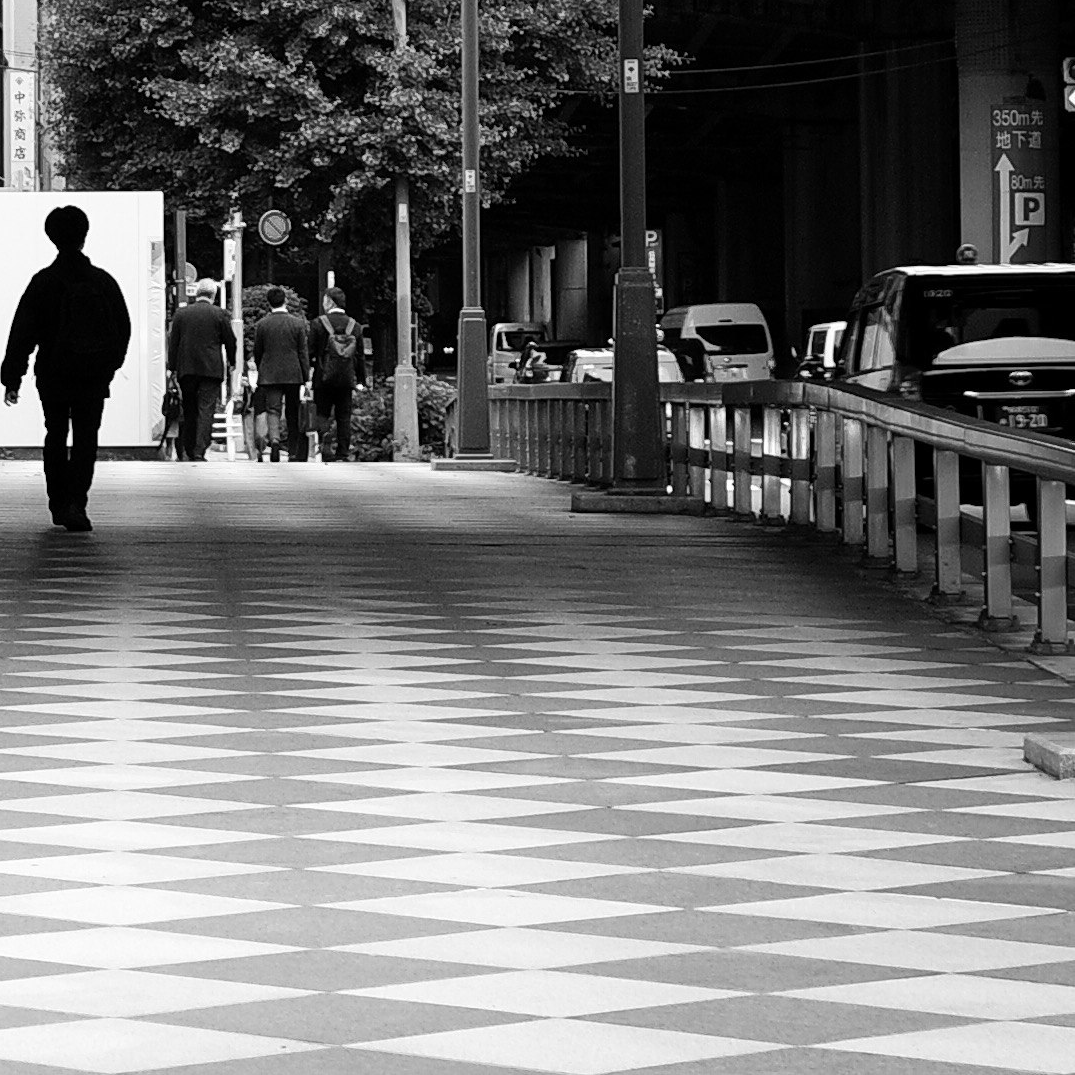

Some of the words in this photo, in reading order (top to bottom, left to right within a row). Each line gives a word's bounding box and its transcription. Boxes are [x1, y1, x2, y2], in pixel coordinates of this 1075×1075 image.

[993, 110, 1043, 126] 350m先
[996, 131, 1041, 148] 地下道
[1011, 175, 1045, 189] 80m先
[1023, 197, 1040, 221] P
[645, 229, 658, 247] P
